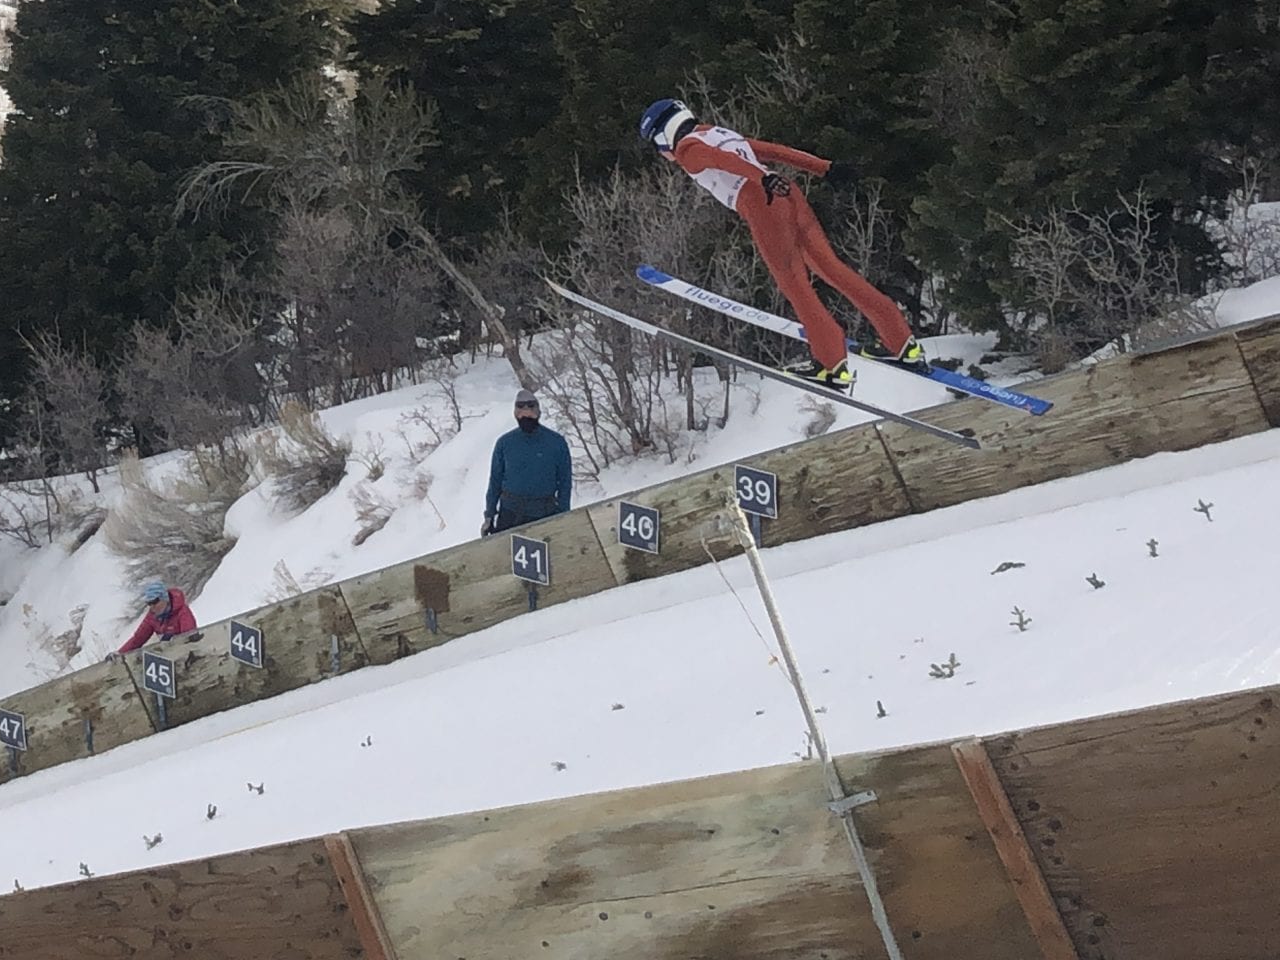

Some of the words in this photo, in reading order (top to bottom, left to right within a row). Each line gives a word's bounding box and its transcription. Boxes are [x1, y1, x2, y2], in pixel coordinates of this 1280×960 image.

[738, 476, 771, 506] 39
[622, 513, 653, 541] 40
[515, 545, 541, 574] 41
[231, 630, 257, 657] 44
[146, 662, 171, 687] 45
[0, 717, 21, 740] 47
